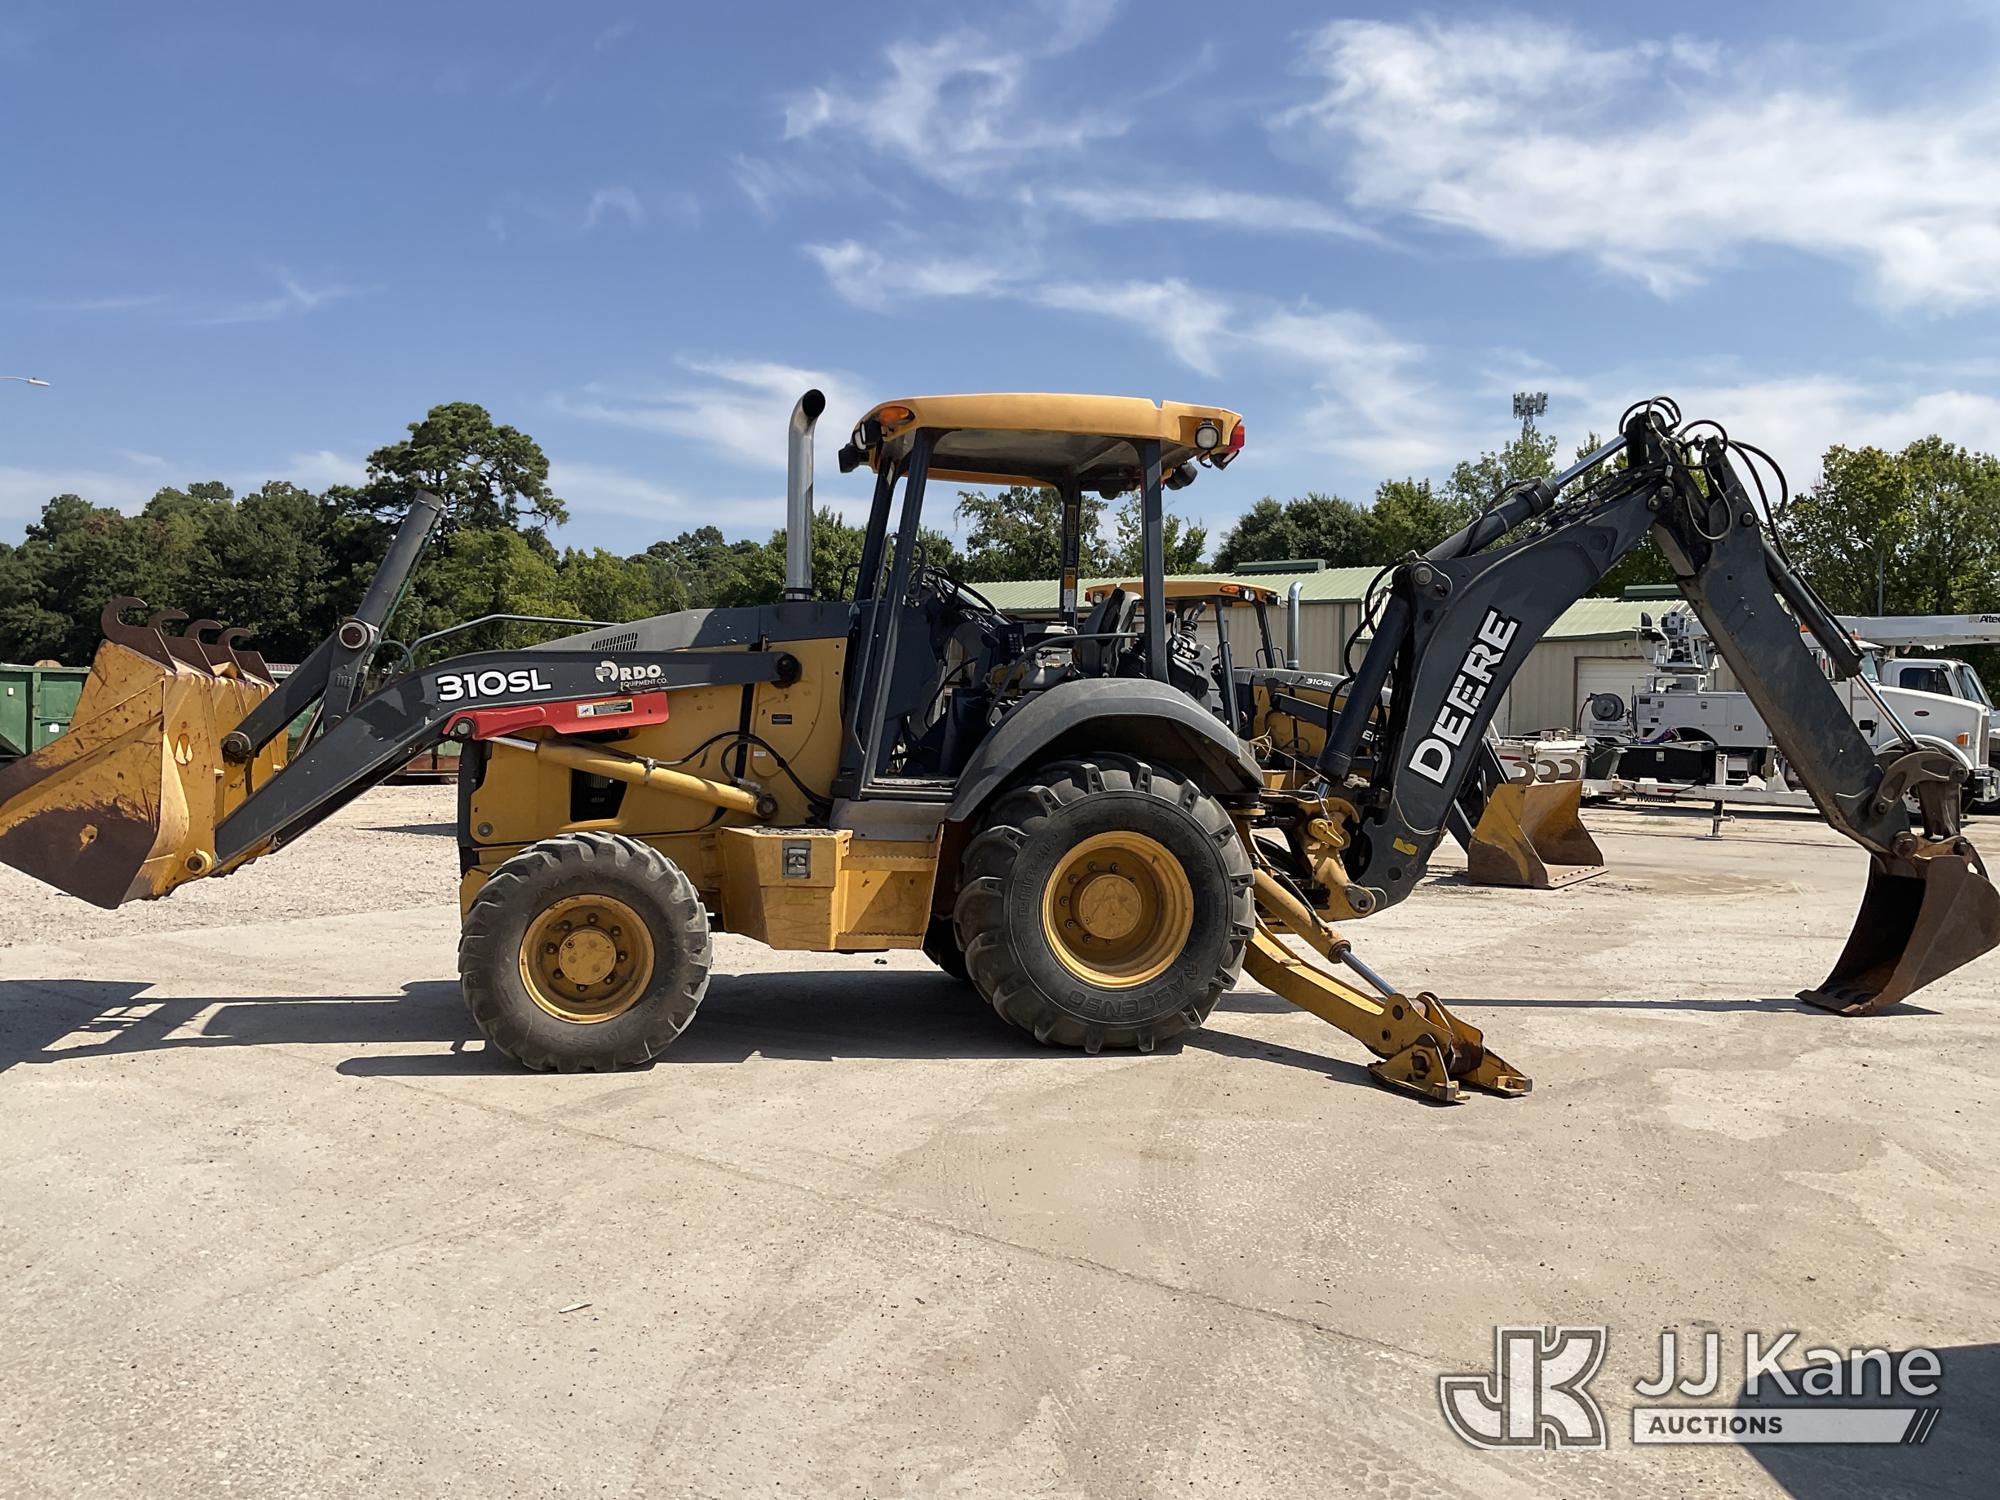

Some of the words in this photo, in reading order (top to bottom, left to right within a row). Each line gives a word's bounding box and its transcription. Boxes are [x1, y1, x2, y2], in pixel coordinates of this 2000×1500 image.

[437, 669, 552, 701] 310SL
[1305, 678, 1333, 687] 310SL
[1408, 610, 1518, 784] DEERE
